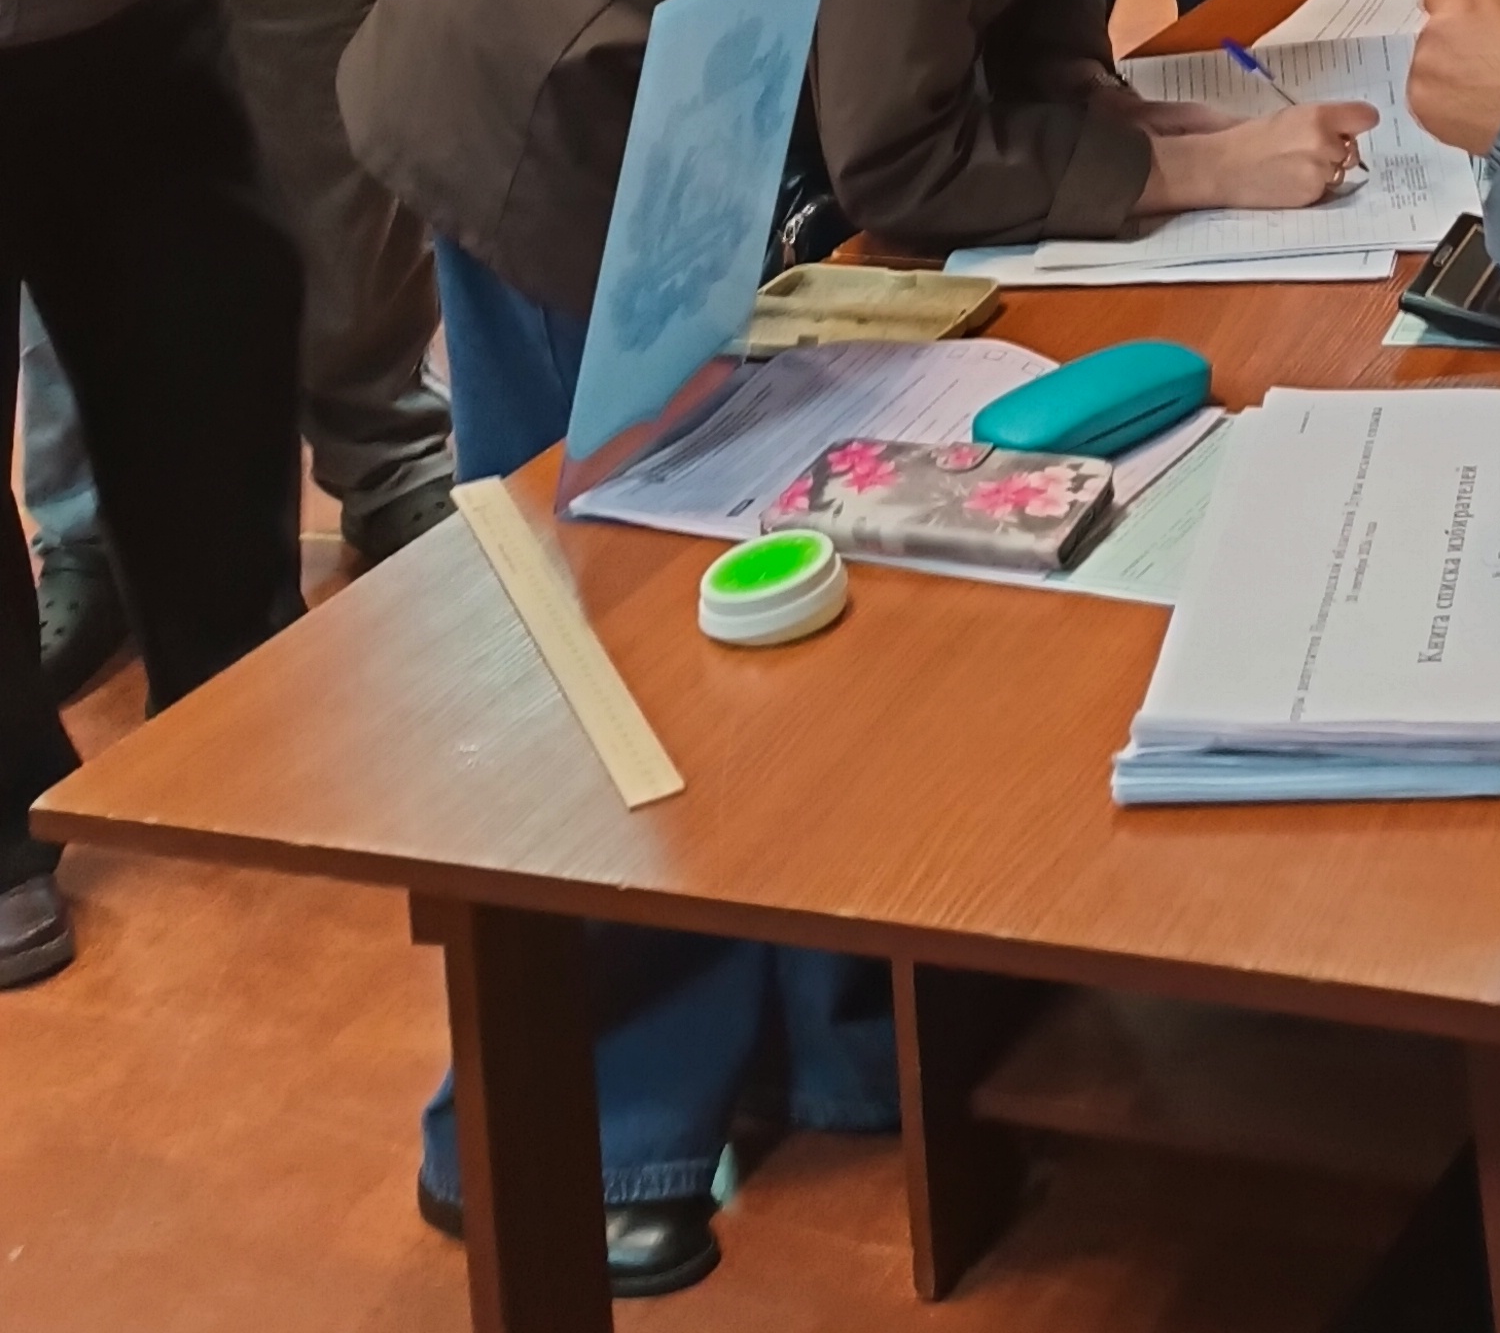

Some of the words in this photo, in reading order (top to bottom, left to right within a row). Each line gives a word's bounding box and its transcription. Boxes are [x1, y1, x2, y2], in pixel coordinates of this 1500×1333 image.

[1445, 465, 1477, 552] избирателей
[1436, 558, 1461, 609] списка
[1417, 614, 1450, 663] Книга
